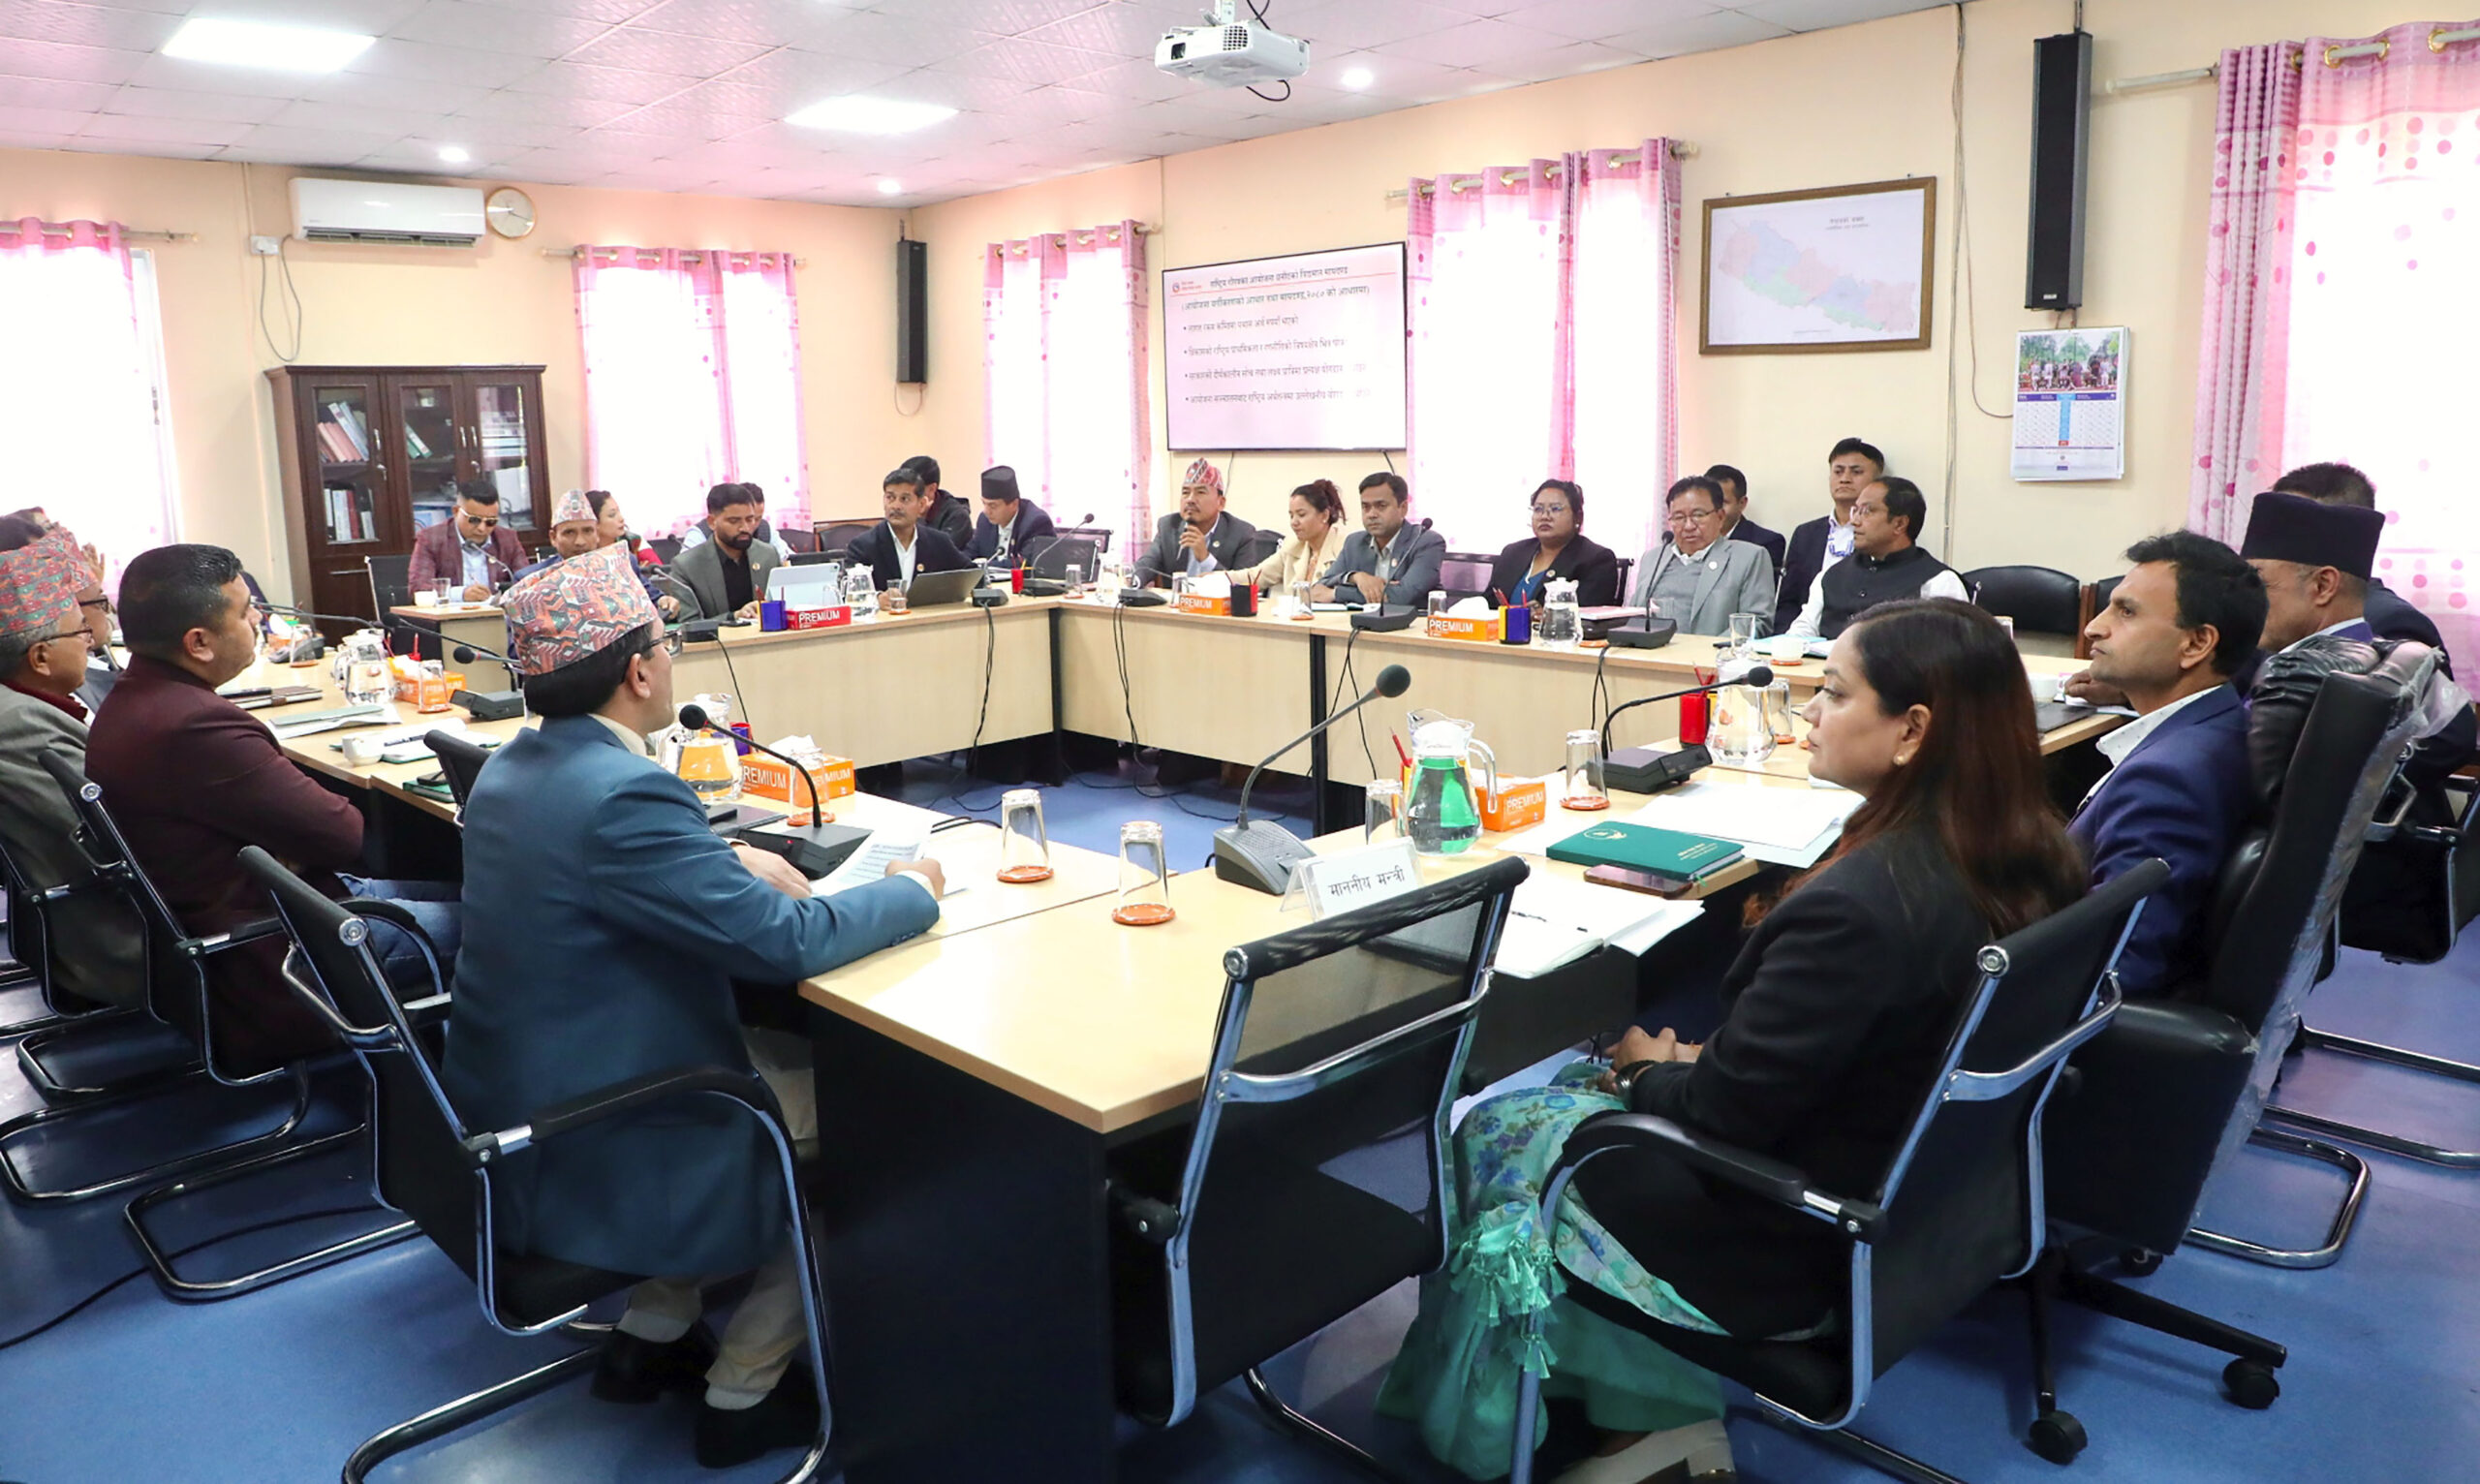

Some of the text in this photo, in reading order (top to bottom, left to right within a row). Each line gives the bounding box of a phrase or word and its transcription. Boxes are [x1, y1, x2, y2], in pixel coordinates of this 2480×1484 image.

[798, 609, 840, 624] PREMIUM
[1429, 618, 1473, 633] PREMIUM
[743, 765, 787, 789] REMIUM
[1328, 864, 1405, 896] माननीय मन्त्री
